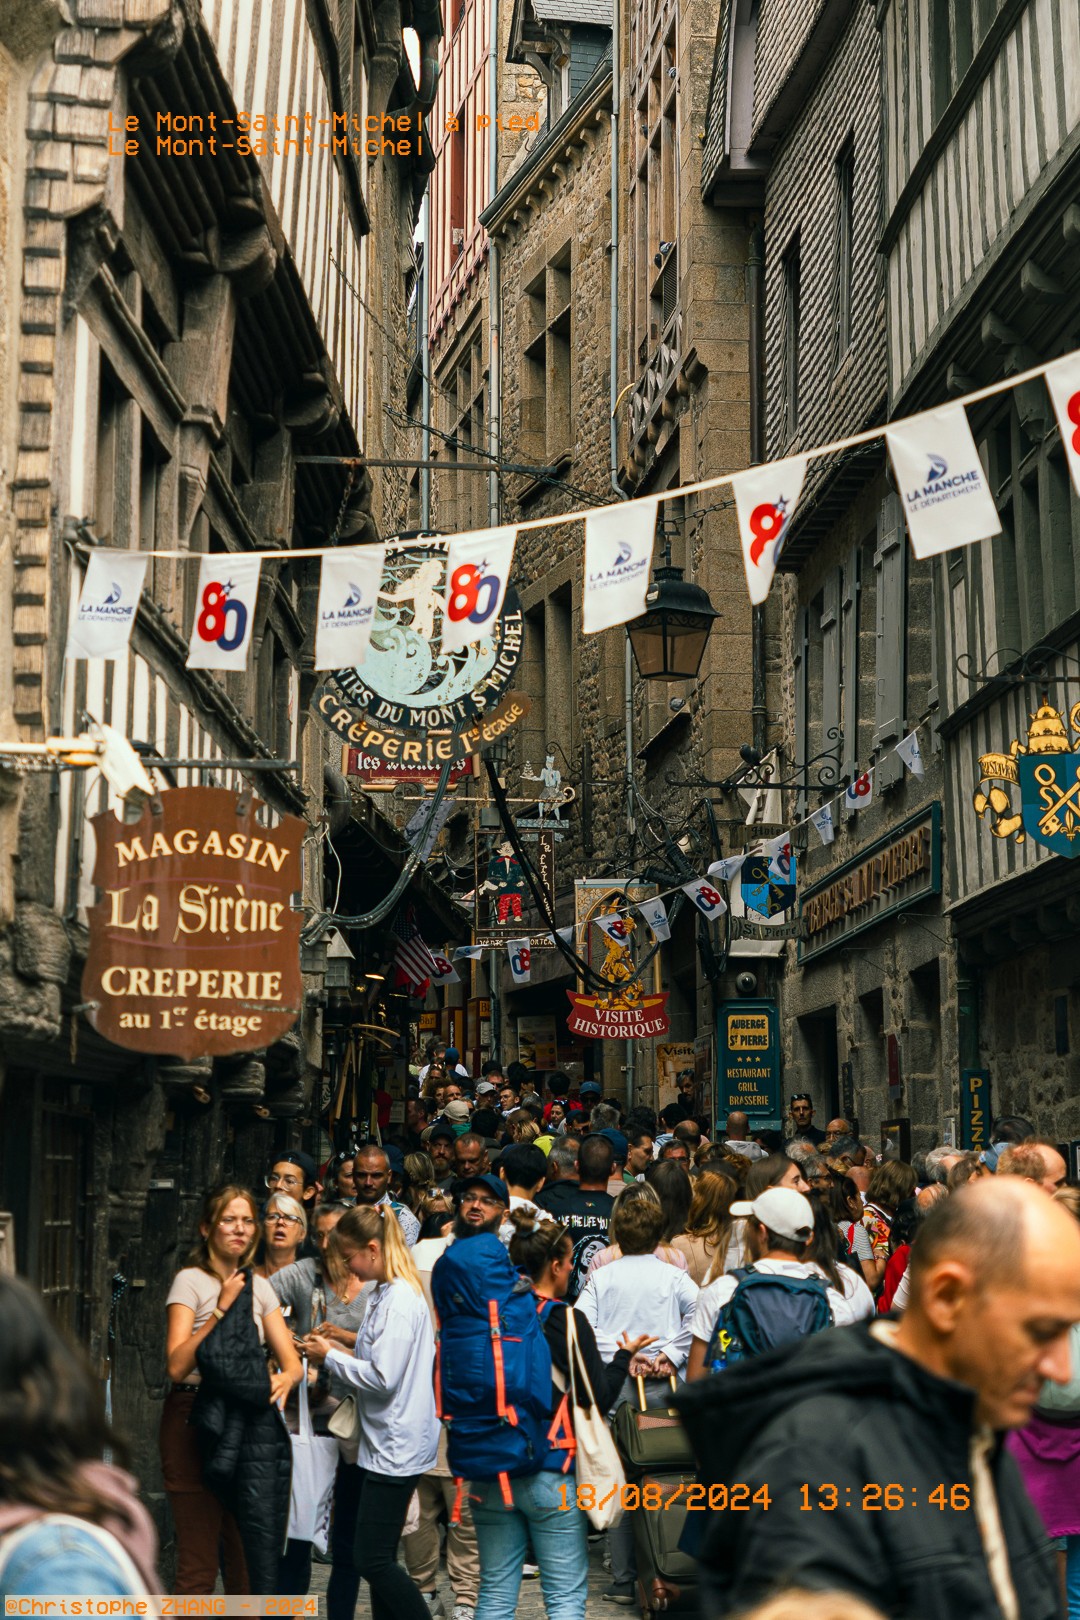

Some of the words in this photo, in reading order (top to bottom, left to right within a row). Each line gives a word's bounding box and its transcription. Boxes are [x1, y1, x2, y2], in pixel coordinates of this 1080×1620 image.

[907, 489, 921, 503] LA
[923, 470, 980, 496] MANCHE
[448, 564, 500, 624] 80
[197, 581, 247, 652] 80
[375, 702, 403, 723] DU
[409, 699, 467, 728] MONT
[486, 609, 522, 692] MICHEL
[115, 829, 290, 873] MAGASIN
[105, 886, 160, 932] La
[173, 884, 285, 943] Sirène
[764, 926, 797, 938] Pierre
[101, 965, 282, 1001] CREPERIE
[119, 1012, 151, 1029] au
[194, 1009, 262, 1037] étage
[595, 1009, 645, 1023] VISITE
[731, 1019, 766, 1029] AUBERGE
[573, 1017, 666, 1039] HISTORIQUE
[740, 1034, 767, 1046] PIERRE
[727, 1068, 771, 1078] RESTAURANT
[738, 1082, 759, 1092] GRILL
[729, 1095, 769, 1106] BRASSERIE
[571, 1214, 583, 1228] THE
